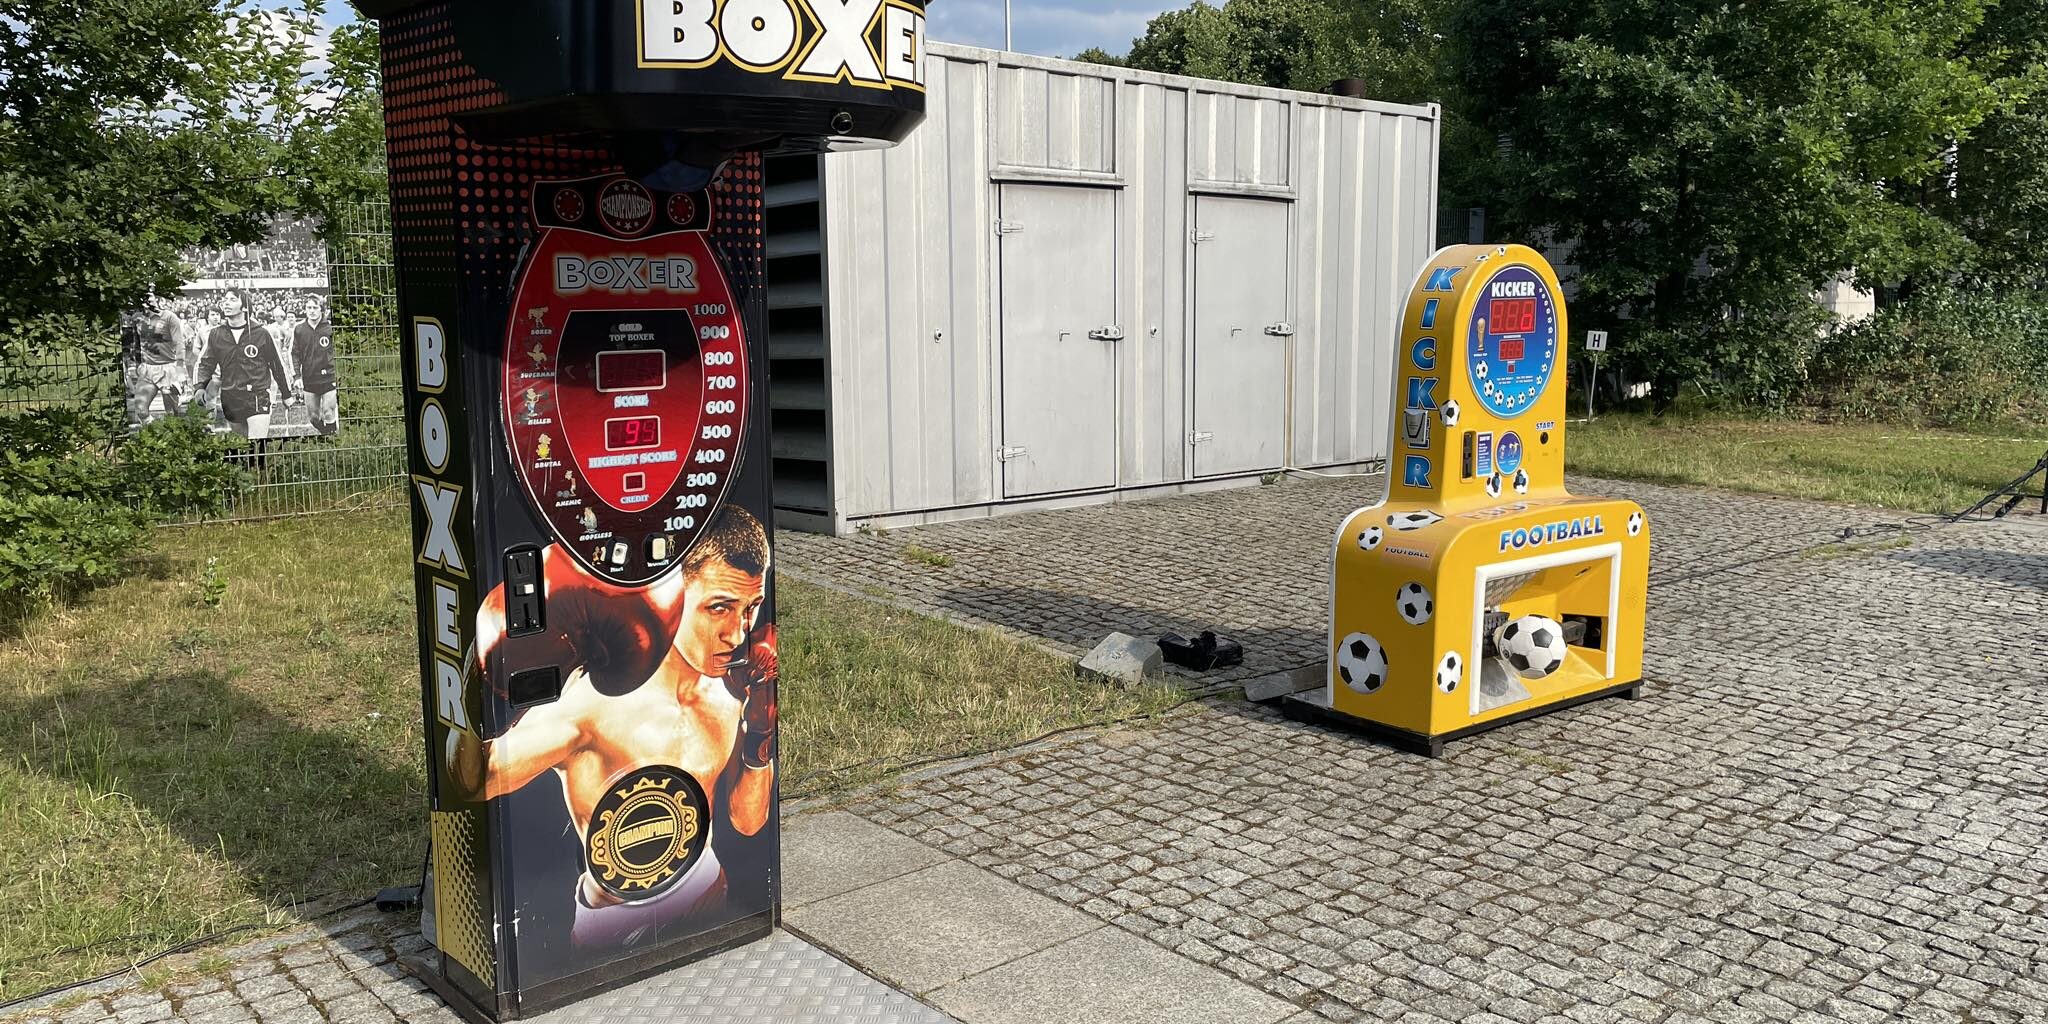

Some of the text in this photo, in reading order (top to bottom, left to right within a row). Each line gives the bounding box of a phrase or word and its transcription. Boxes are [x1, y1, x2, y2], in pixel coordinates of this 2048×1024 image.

[602, 194, 651, 219] CHAMPIONSHIP
[557, 256, 696, 290] BOXER
[1491, 281, 1536, 297] KICKER
[694, 303, 726, 315] 1000
[627, 333, 655, 341] BOXER
[700, 326, 730, 340] 900
[1592, 334, 1601, 347] H
[704, 351, 734, 365] 800
[520, 371, 555, 379] SUPERMAN
[707, 376, 736, 390] 700
[614, 393, 650, 408] SCORE
[705, 400, 736, 414] 600
[701, 425, 732, 439] 500
[1535, 421, 1555, 430] START
[588, 450, 678, 469] HIGHEST SCORE
[694, 449, 725, 464] 400
[535, 461, 562, 469] BRUTAL
[686, 472, 717, 488] 300
[555, 498, 582, 507] ANEMIC
[620, 494, 650, 504] CREDIT
[675, 493, 707, 510] 200
[411, 316, 470, 734] BOXER
[663, 515, 695, 531] 100
[579, 531, 613, 541] HOPELESS
[1499, 515, 1604, 553] FOOTBALL
[1385, 547, 1430, 559] FOOTBALL
[618, 819, 674, 848] CHAMPION
